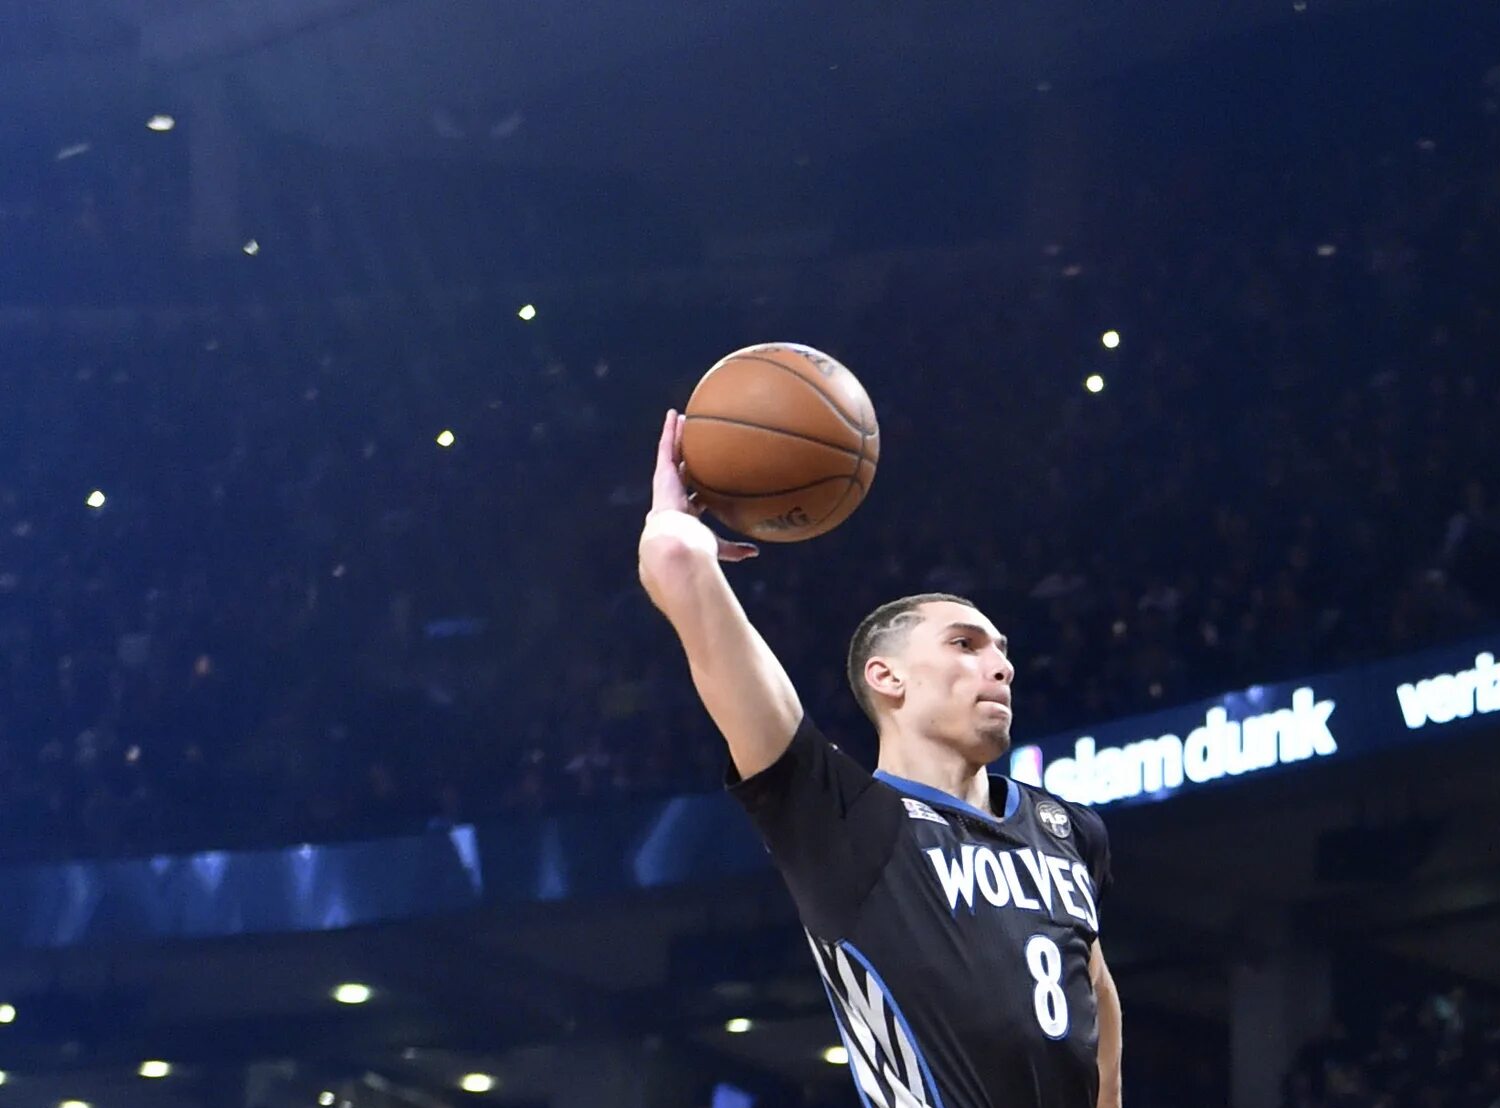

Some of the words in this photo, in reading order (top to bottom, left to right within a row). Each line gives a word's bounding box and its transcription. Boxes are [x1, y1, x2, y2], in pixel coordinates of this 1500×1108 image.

[1043, 735, 1184, 806] slam
[1183, 686, 1338, 783] dunk
[925, 841, 1100, 934] WOLVES
[1026, 933, 1072, 1041] 8
